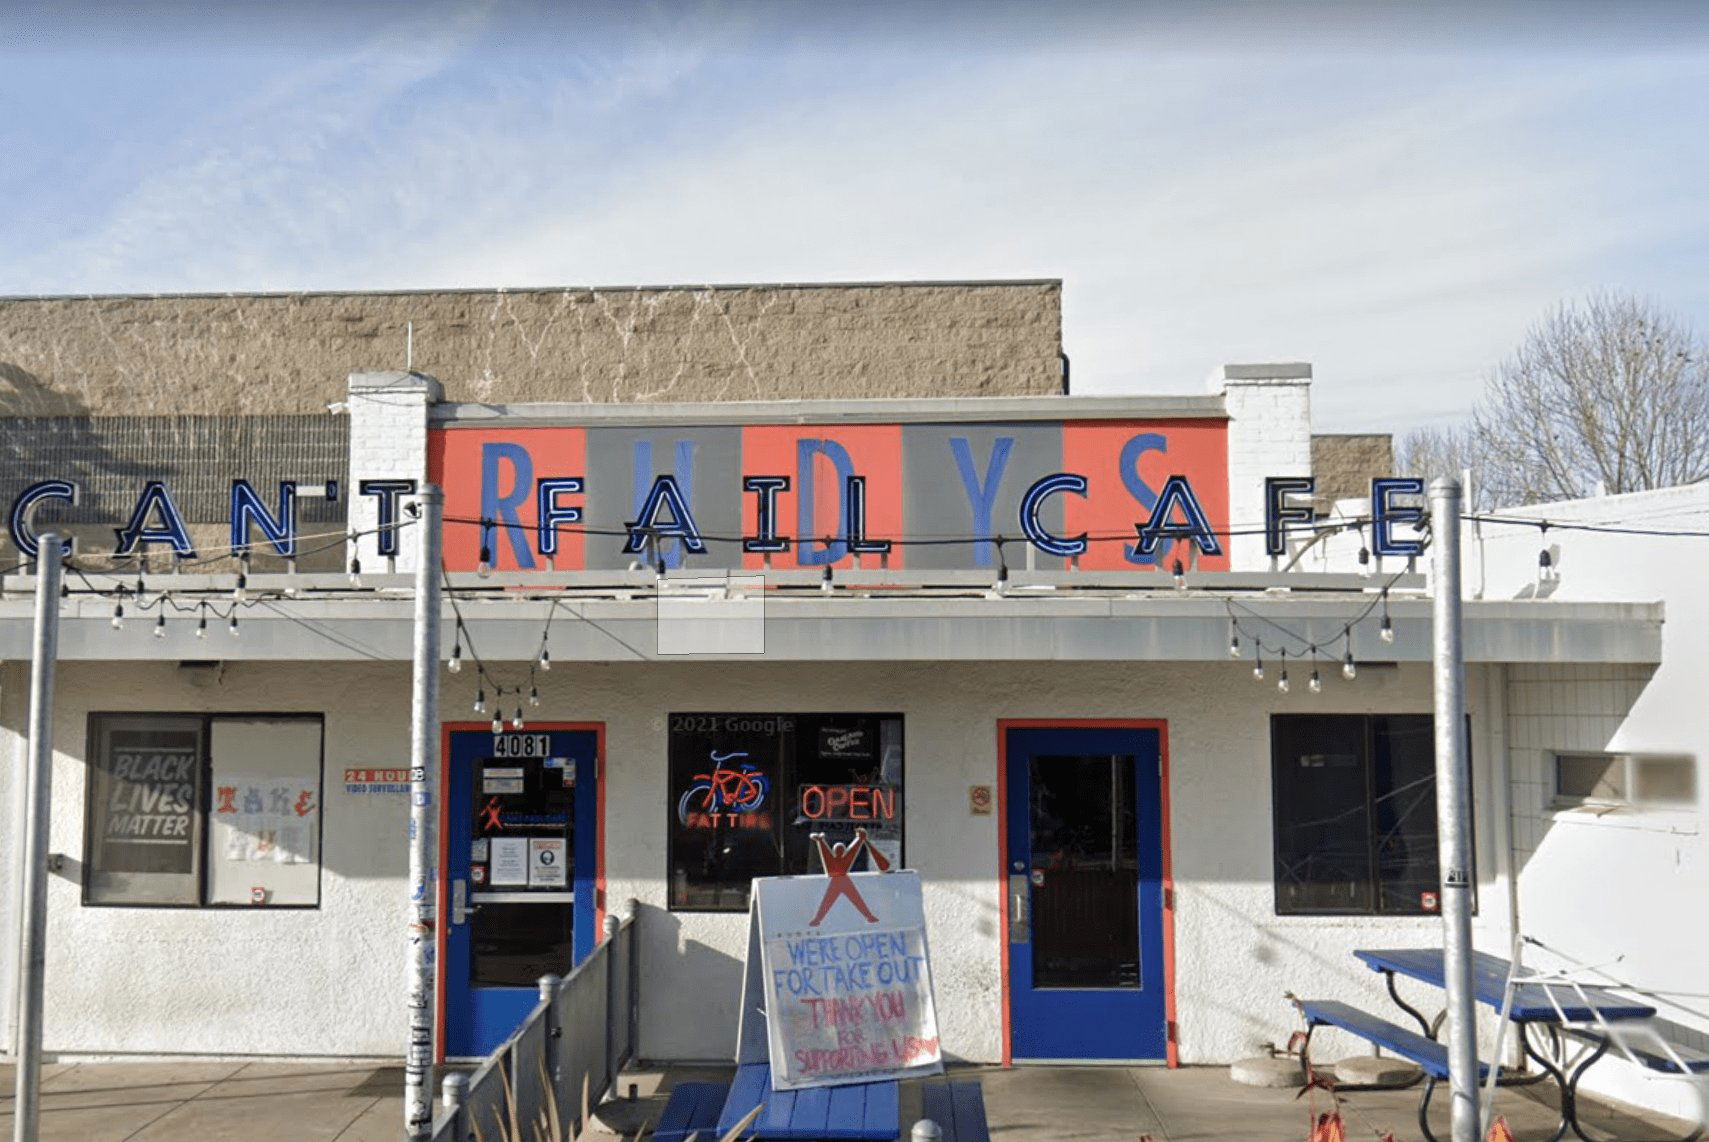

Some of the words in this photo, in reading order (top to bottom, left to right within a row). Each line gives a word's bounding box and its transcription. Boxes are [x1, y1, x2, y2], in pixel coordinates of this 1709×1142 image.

[9, 479, 417, 558] CAN'T
[536, 474, 892, 555] FAIL
[1019, 473, 1425, 557] CAFE
[495, 735, 548, 757] 4081
[113, 754, 194, 782] BLACK
[345, 770, 367, 782] 24
[374, 770, 411, 782] HOU
[109, 783, 194, 814] LIVES
[369, 783, 411, 793] SURVEILLAN
[801, 785, 896, 820] OPEN
[108, 815, 188, 837] MATTER
[845, 931, 908, 960] OPEN
[774, 966, 822, 1000] FOR
[818, 961, 873, 992] TAKE
[877, 956, 923, 985] OUT
[864, 990, 906, 1025] YOU
